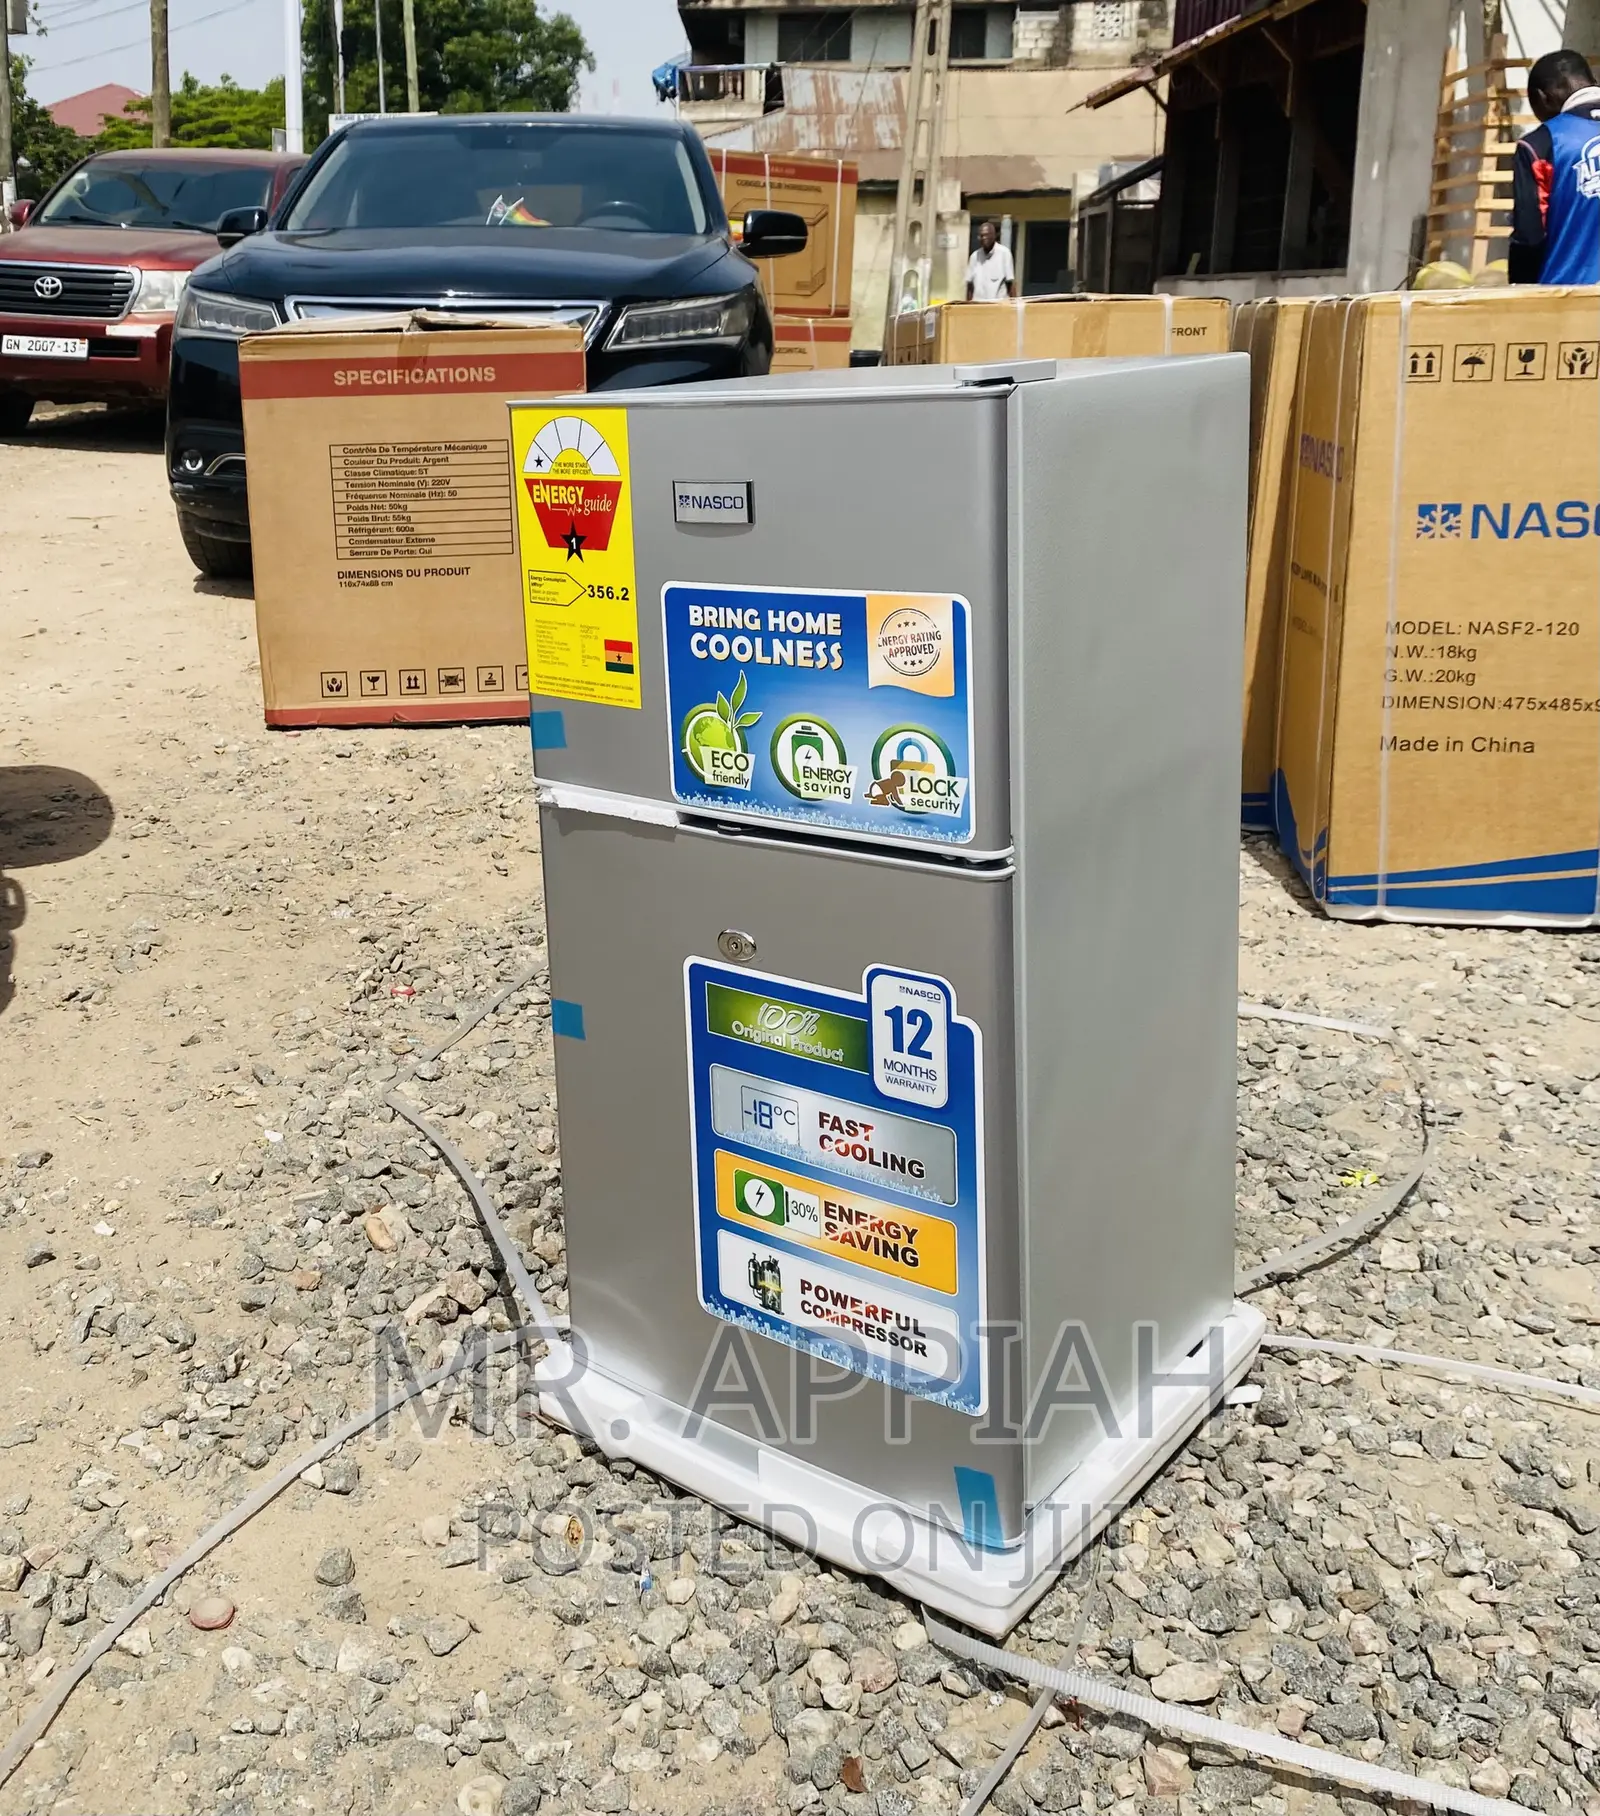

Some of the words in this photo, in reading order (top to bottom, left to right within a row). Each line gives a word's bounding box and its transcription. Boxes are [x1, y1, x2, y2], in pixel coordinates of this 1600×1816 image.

[6, 338, 21, 351] GN
[27, 339, 77, 353] 2007-13
[333, 366, 496, 386] SPECIFICATIONS
[342, 444, 377, 455] Contrôle
[379, 444, 390, 454] De
[391, 443, 442, 454] Température
[444, 442, 488, 453] Mécanique
[343, 457, 375, 467] Couleur
[376, 457, 387, 466] Du
[389, 456, 421, 466] Produit:
[422, 455, 449, 465] Argent
[344, 469, 371, 478] Classe
[345, 480, 376, 489] Tension
[378, 479, 415, 488] Nominale
[417, 479, 430, 488] (V):
[431, 478, 451, 487] 220V
[345, 491, 388, 502] Fréquence
[389, 490, 427, 500] Nominale
[428, 489, 446, 499] (Hz):
[447, 489, 458, 498] 50
[532, 480, 585, 511] ENERGY
[583, 493, 612, 516] guide
[691, 495, 744, 510] NASCO
[346, 503, 368, 512] Poids
[370, 503, 387, 511] Net:
[388, 503, 408, 513] 50kg
[347, 515, 370, 524] Poids
[371, 515, 391, 523] Brut:
[392, 514, 412, 523] 55kg
[1471, 501, 1600, 539] NAS
[395, 525, 415, 534] 600a
[348, 537, 403, 546] Condensateur
[405, 536, 436, 545] Externe
[570, 537, 578, 550] 1
[349, 549, 379, 558] Serrure
[380, 548, 392, 556] De
[393, 548, 418, 556] Porte:
[337, 568, 404, 580] DIMENSIONS
[406, 567, 421, 578] DU
[424, 566, 471, 578] PRODUIT
[381, 580, 394, 588] cm
[587, 584, 630, 601] 356.2
[688, 604, 761, 632] BRING
[768, 609, 842, 637] HOME
[1385, 620, 1462, 636] MODEL:
[1468, 620, 1580, 637] NASF2-120
[910, 630, 942, 644] RATING
[690, 632, 843, 671] COOLNESS
[888, 643, 934, 658] APPROVED
[1380, 735, 1439, 752] Made
[1446, 735, 1464, 752] in
[1471, 736, 1536, 753] China
[711, 750, 749, 771] ECO
[711, 770, 750, 789] friendly
[802, 765, 852, 784] ENERGY
[803, 780, 852, 800] saving
[910, 775, 960, 797] LOCK
[910, 796, 960, 814] security
[905, 986, 941, 1001] NASCO
[756, 1002, 822, 1036] 100%
[731, 1019, 787, 1048] Original
[790, 1035, 845, 1063] Product
[884, 1004, 934, 1061] 12
[883, 1058, 938, 1082] MONTHS
[885, 1074, 938, 1095] WARRANTY
[818, 1111, 875, 1142] FAST
[818, 1135, 926, 1180] COOLING
[790, 1199, 819, 1224] 30%
[823, 1200, 919, 1246] ENERGY
[824, 1222, 920, 1268] SAVING
[799, 1278, 927, 1339] POWERFUL
[800, 1299, 928, 1358] COMPRESSOR
